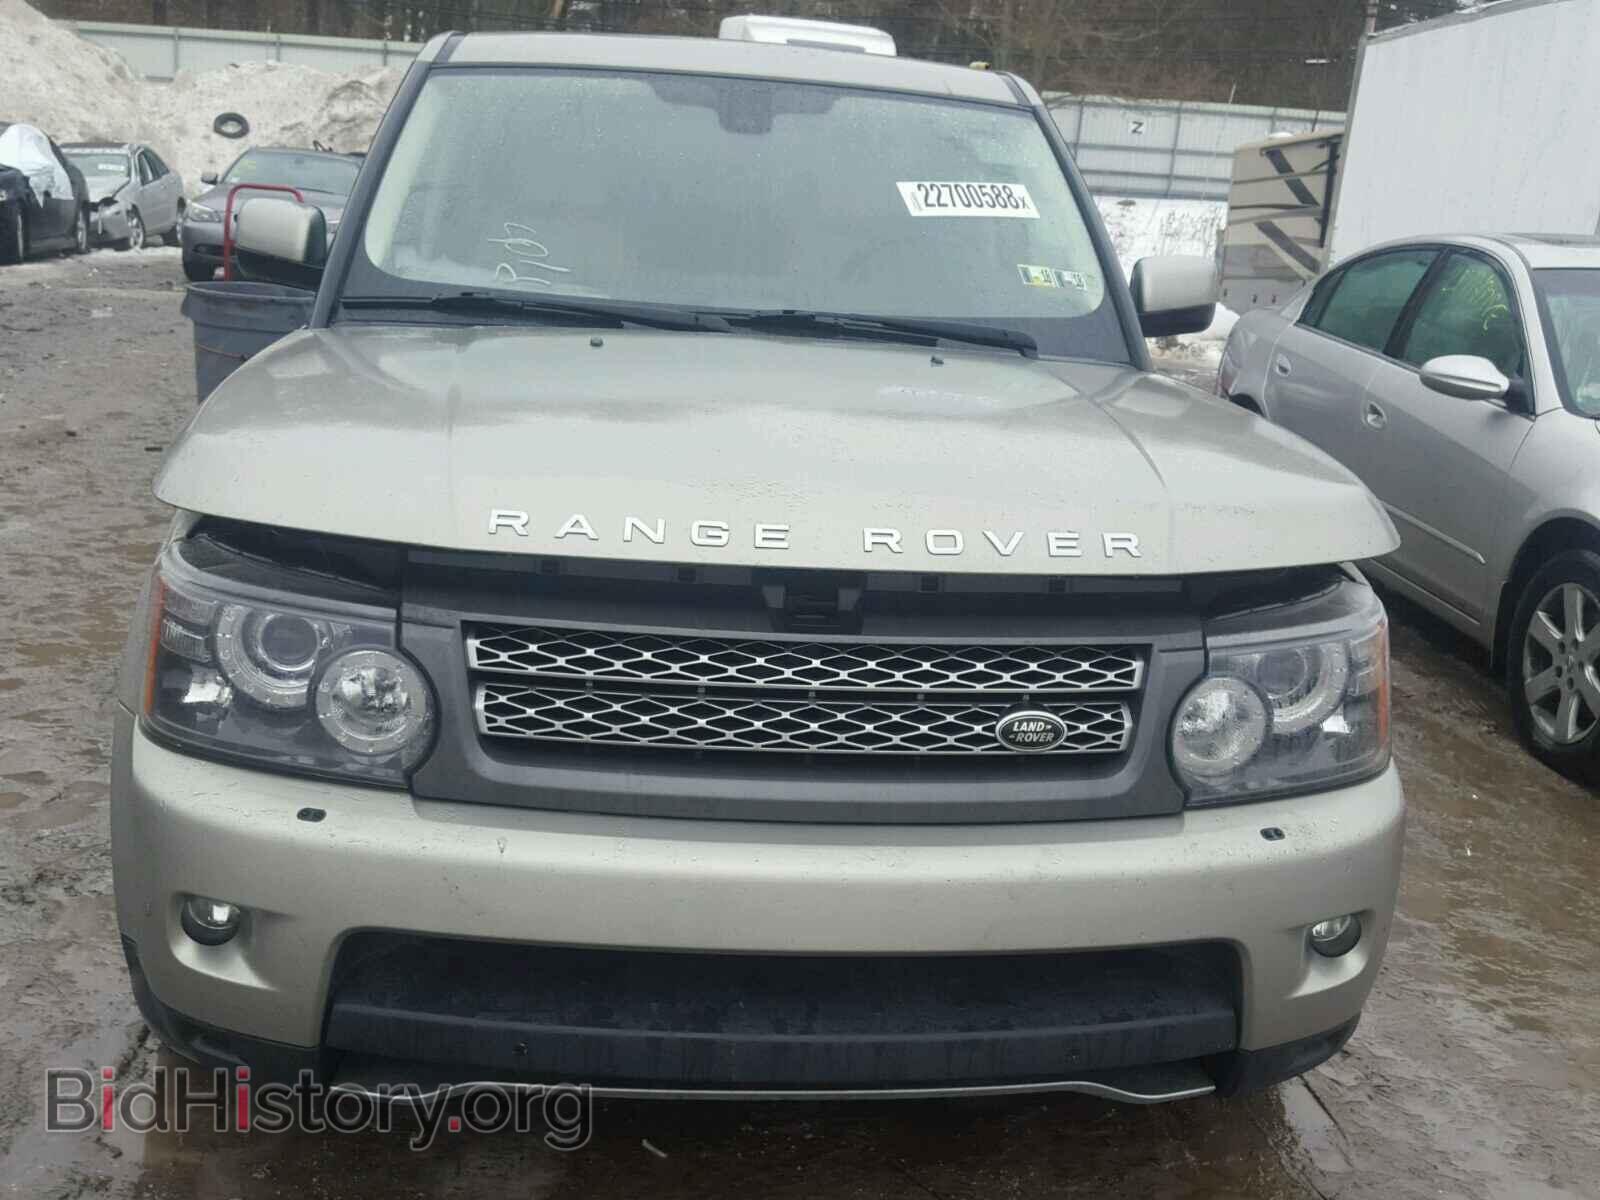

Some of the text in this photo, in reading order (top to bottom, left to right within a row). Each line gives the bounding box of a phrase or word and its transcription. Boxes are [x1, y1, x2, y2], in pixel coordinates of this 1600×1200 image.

[1130, 120, 1145, 135] Z
[487, 508, 1142, 558] RANGE ROVER
[1012, 721, 1046, 732] LAND
[1014, 732, 1055, 743] ROVER
